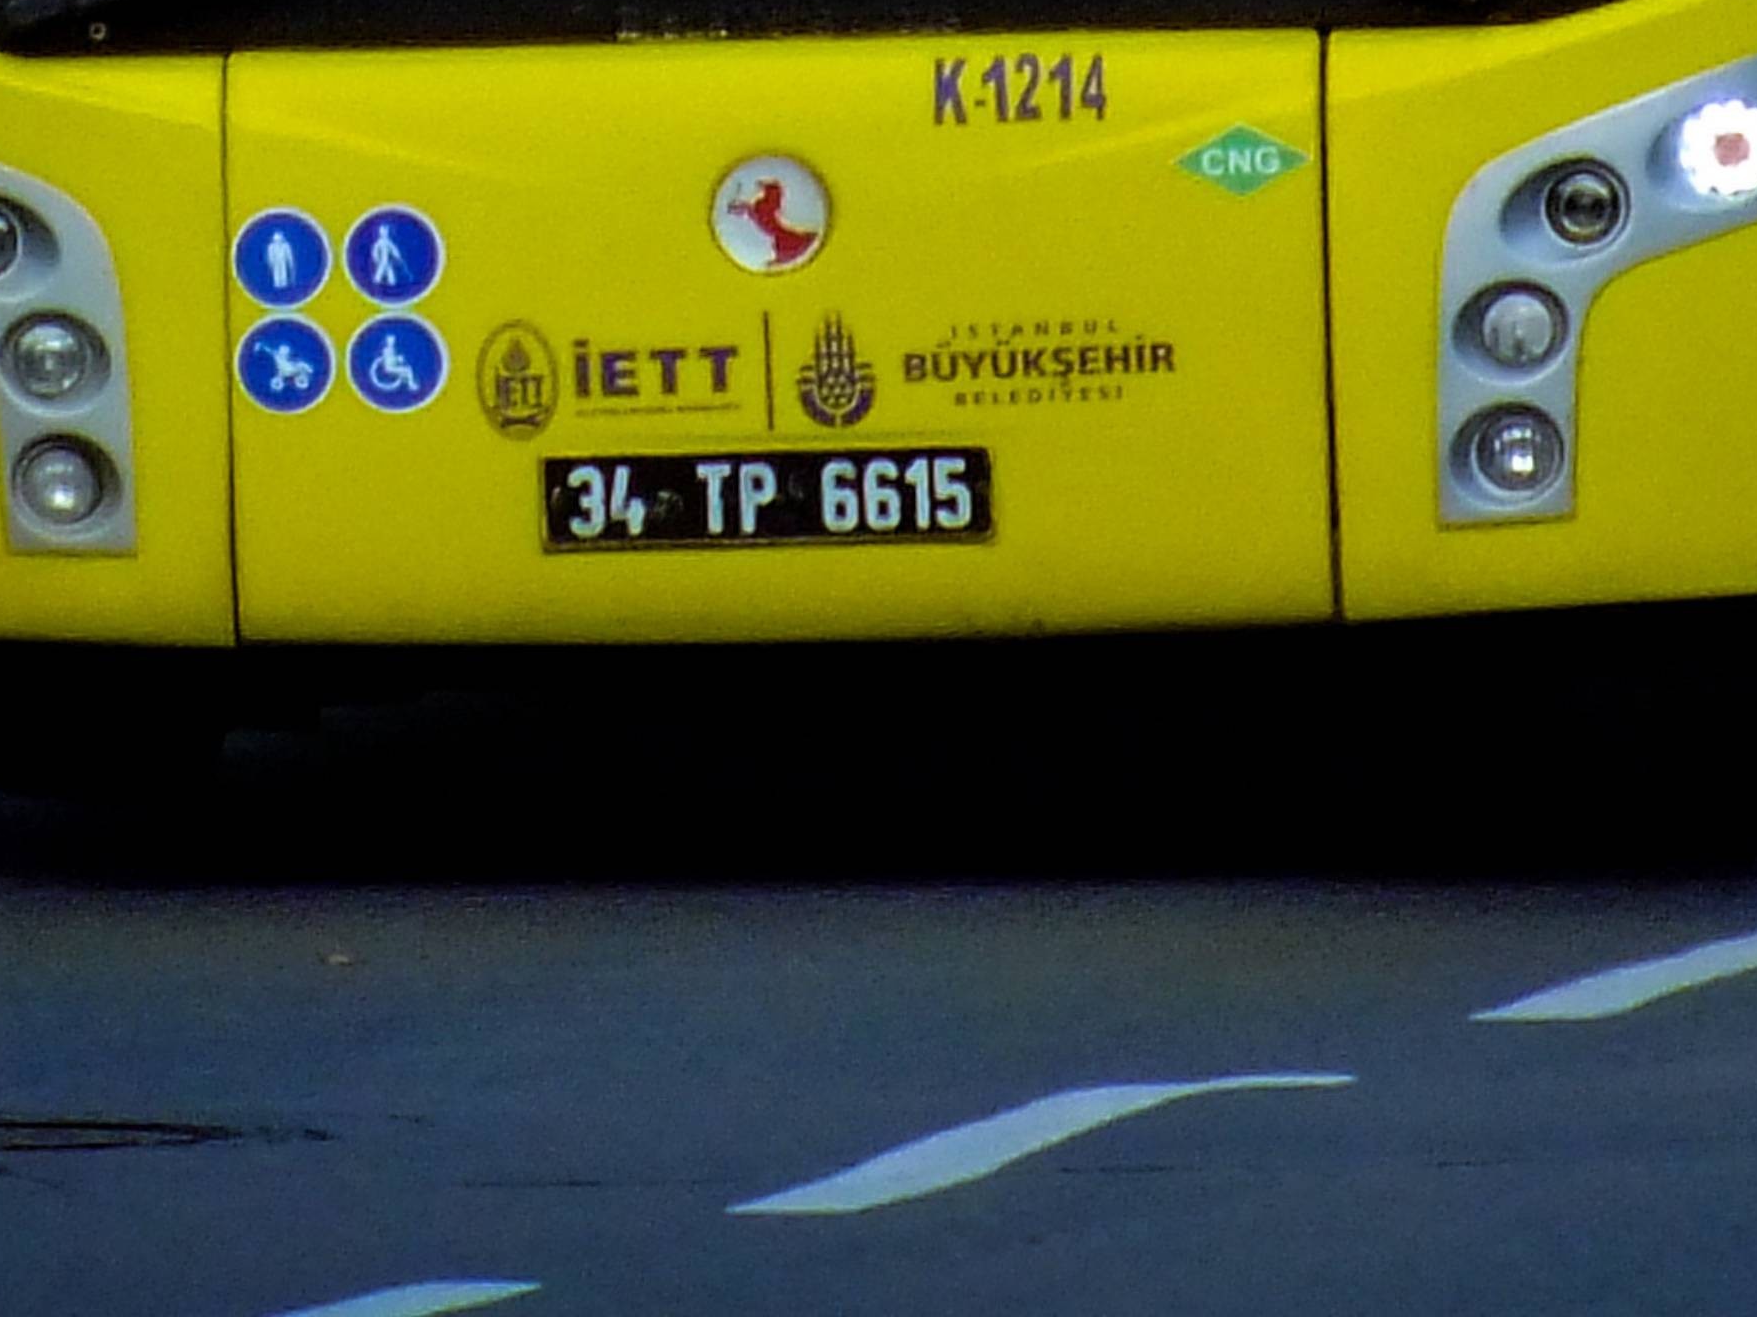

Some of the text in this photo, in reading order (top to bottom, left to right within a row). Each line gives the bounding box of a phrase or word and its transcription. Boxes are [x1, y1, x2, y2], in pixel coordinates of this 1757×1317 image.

[933, 51, 1108, 126] K-1214
[1200, 145, 1281, 177] CNG
[573, 338, 739, 399] İETT
[903, 333, 1176, 387] BÜYÜKŞEHİR
[567, 454, 974, 540] 34 TP 6615
